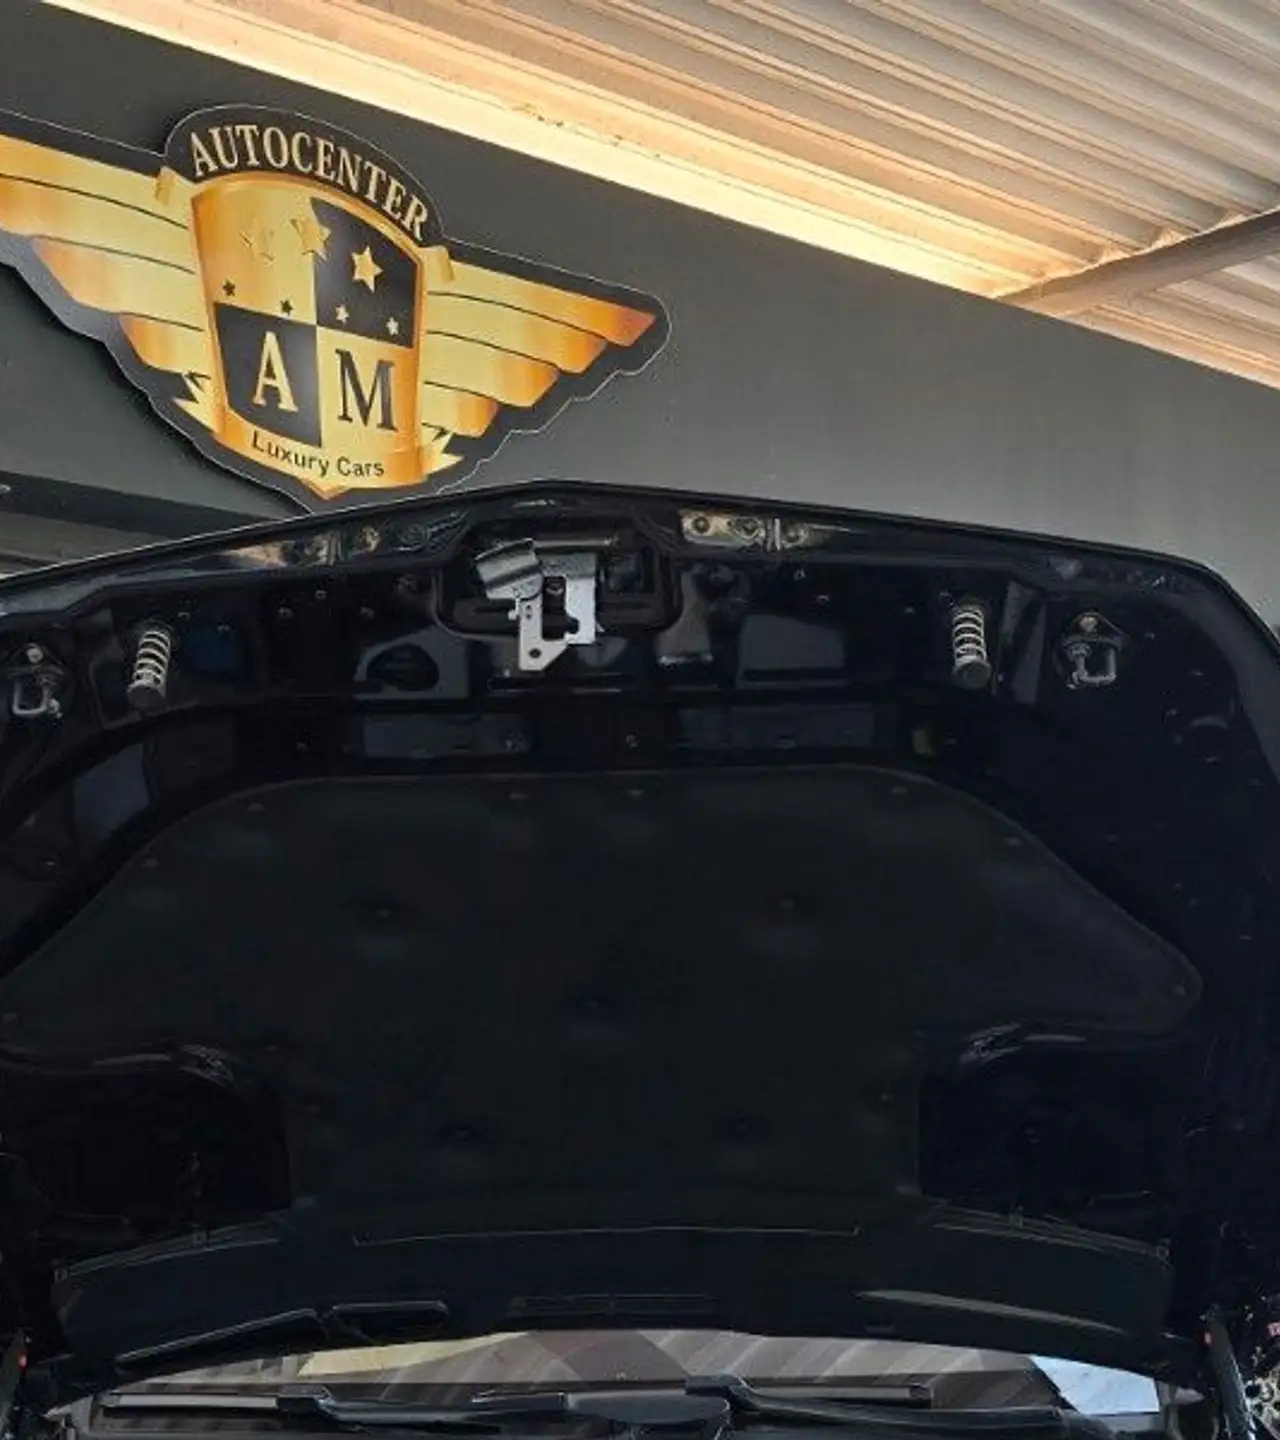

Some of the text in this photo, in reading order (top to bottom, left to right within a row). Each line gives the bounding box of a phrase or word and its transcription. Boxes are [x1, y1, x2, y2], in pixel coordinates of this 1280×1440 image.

[190, 124, 429, 241] AUTOCENTER
[251, 331, 399, 433] A M
[251, 429, 386, 478] Luxury Cars
